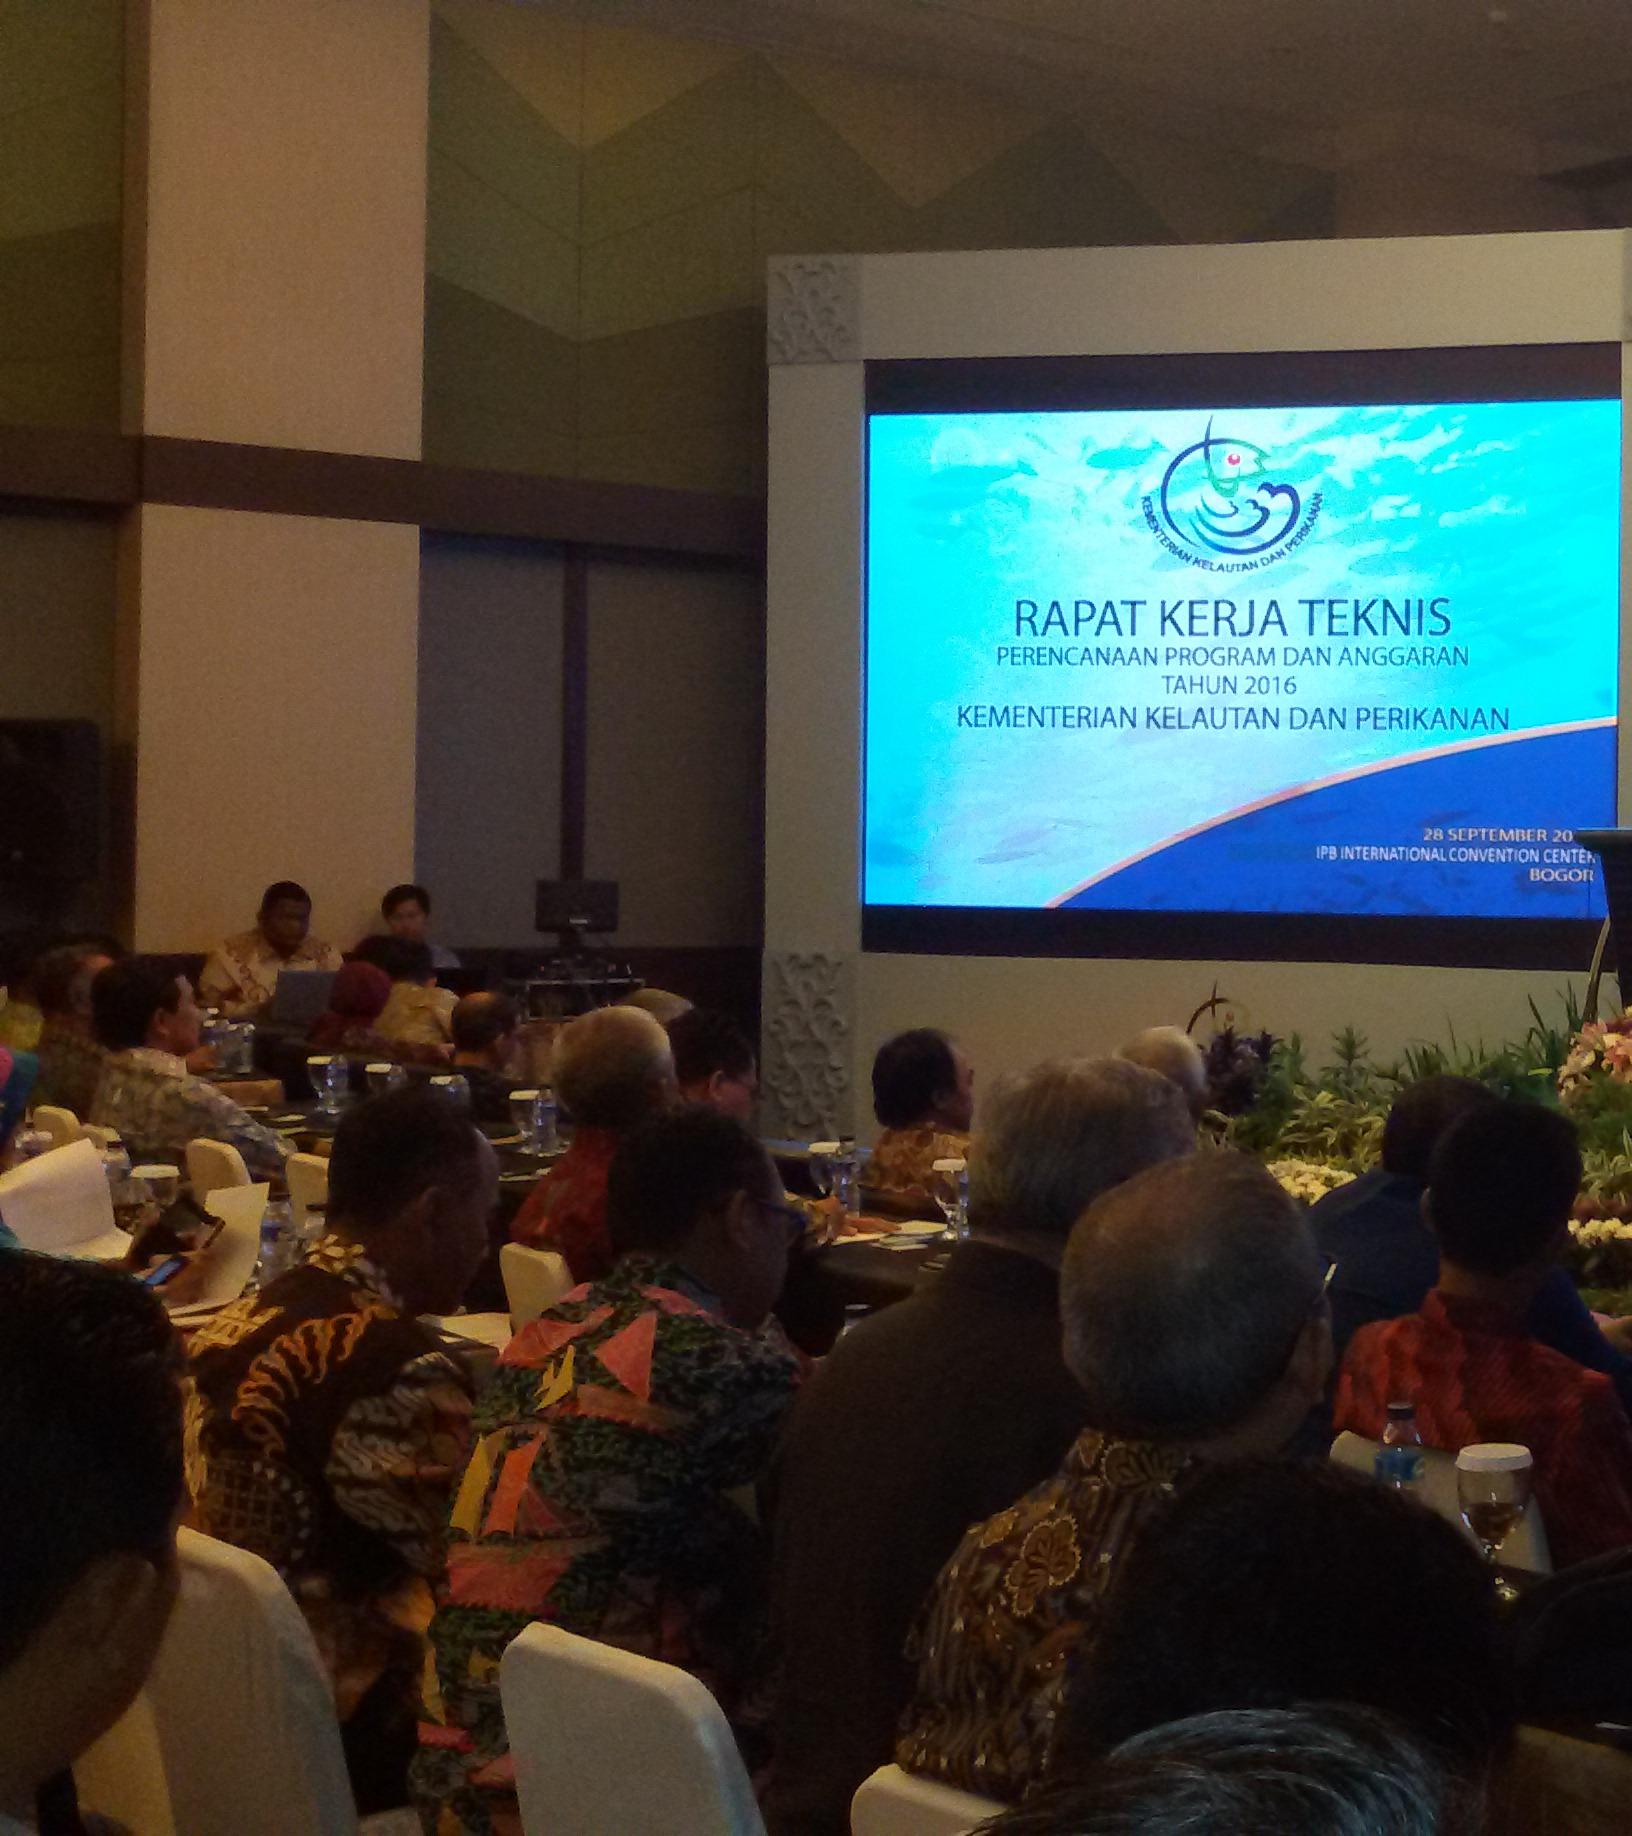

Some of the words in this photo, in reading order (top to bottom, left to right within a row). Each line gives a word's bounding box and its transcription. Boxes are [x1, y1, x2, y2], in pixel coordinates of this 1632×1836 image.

[1141, 495, 1192, 563] KEMENTERIAN
[1192, 556, 1258, 573] KELAUTAN
[1260, 549, 1286, 567] DAN
[1015, 599, 1147, 637] RAPAT
[1160, 599, 1288, 637] KERJA
[1298, 598, 1451, 637] TEKNIS
[997, 646, 1158, 666] PERENCANAAN
[1165, 646, 1276, 666] PROGRAM
[1283, 646, 1332, 666] DAN
[1337, 645, 1470, 667] ANGGARAN
[1162, 675, 1237, 695] TAHUN
[1244, 675, 1297, 695] 2016
[956, 705, 1137, 729] KEMENTERIAN
[1146, 706, 1280, 730] KELAUTAN
[1289, 706, 1347, 730] DAN
[1356, 707, 1510, 730] PERIKANAN
[1423, 828, 1445, 842] 28
[1447, 828, 1549, 843] SEPTEMBER
[1552, 829, 1574, 843] 20
[1316, 845, 1337, 860] IPB
[1340, 846, 1447, 862] INTERNATIONAL
[1449, 848, 1540, 864] CONVENTION
[1529, 867, 1595, 882] BOGOR
